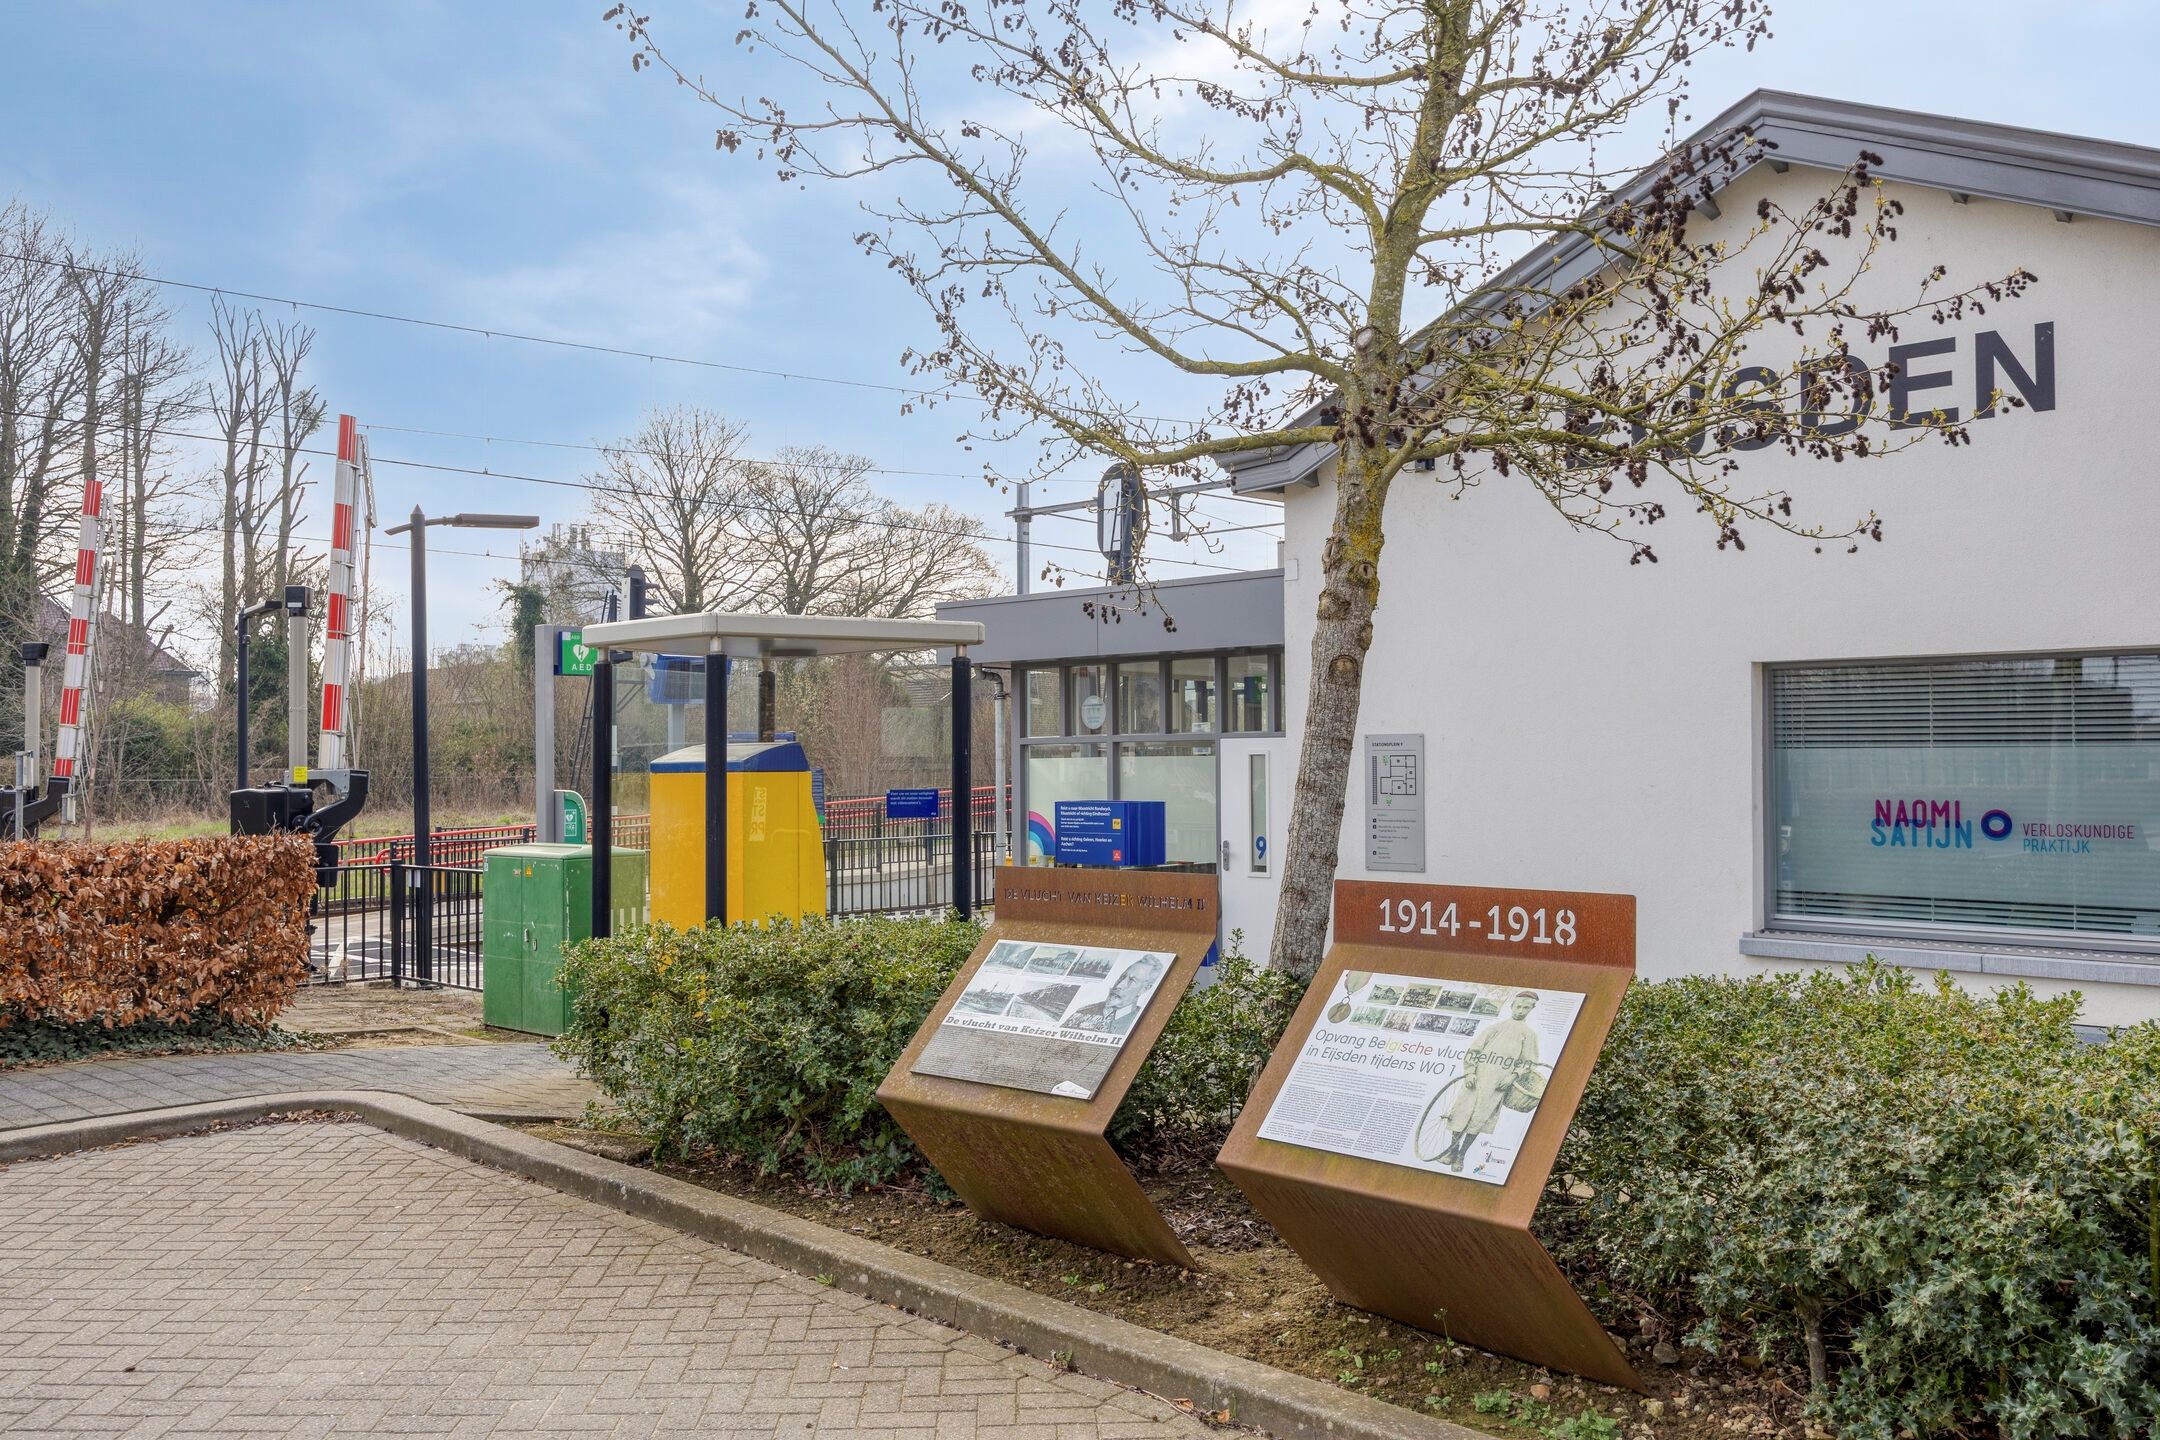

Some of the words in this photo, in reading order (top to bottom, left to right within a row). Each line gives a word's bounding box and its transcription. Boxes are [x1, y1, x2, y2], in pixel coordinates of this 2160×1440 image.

[571, 663, 592, 671] AED
[1875, 799, 1961, 828] NAOMI
[1870, 818, 1972, 849] SATIJN
[2022, 823, 2135, 840] VERLOSKUNDIGE
[1255, 835, 1267, 860] 9
[2023, 838, 2090, 854] PRAKTIJK
[1003, 888, 1018, 900] DE
[1022, 888, 1062, 902] VLUCHT
[1068, 891, 1091, 904] VAN
[1096, 892, 1133, 907] KEIZER
[1137, 895, 1193, 910] WILHELM
[946, 1016, 960, 1025] De
[961, 1018, 995, 1029] vlucht
[998, 1024, 1018, 1033] van
[1021, 1026, 1058, 1038] Keizer
[1060, 1030, 1108, 1044] Wilhelm
[1110, 1037, 1123, 1046] II
[1306, 1044, 1319, 1056] in
[1320, 1046, 1368, 1064] Eijsden
[1370, 1052, 1415, 1071] tijdens
[1419, 1061, 1445, 1076] WO
[1449, 1064, 1456, 1077] 1
[1315, 1029, 1366, 1050] Opvang
[1369, 1036, 1434, 1056] Belgische
[1437, 1045, 1533, 1070] vluchtelingen
